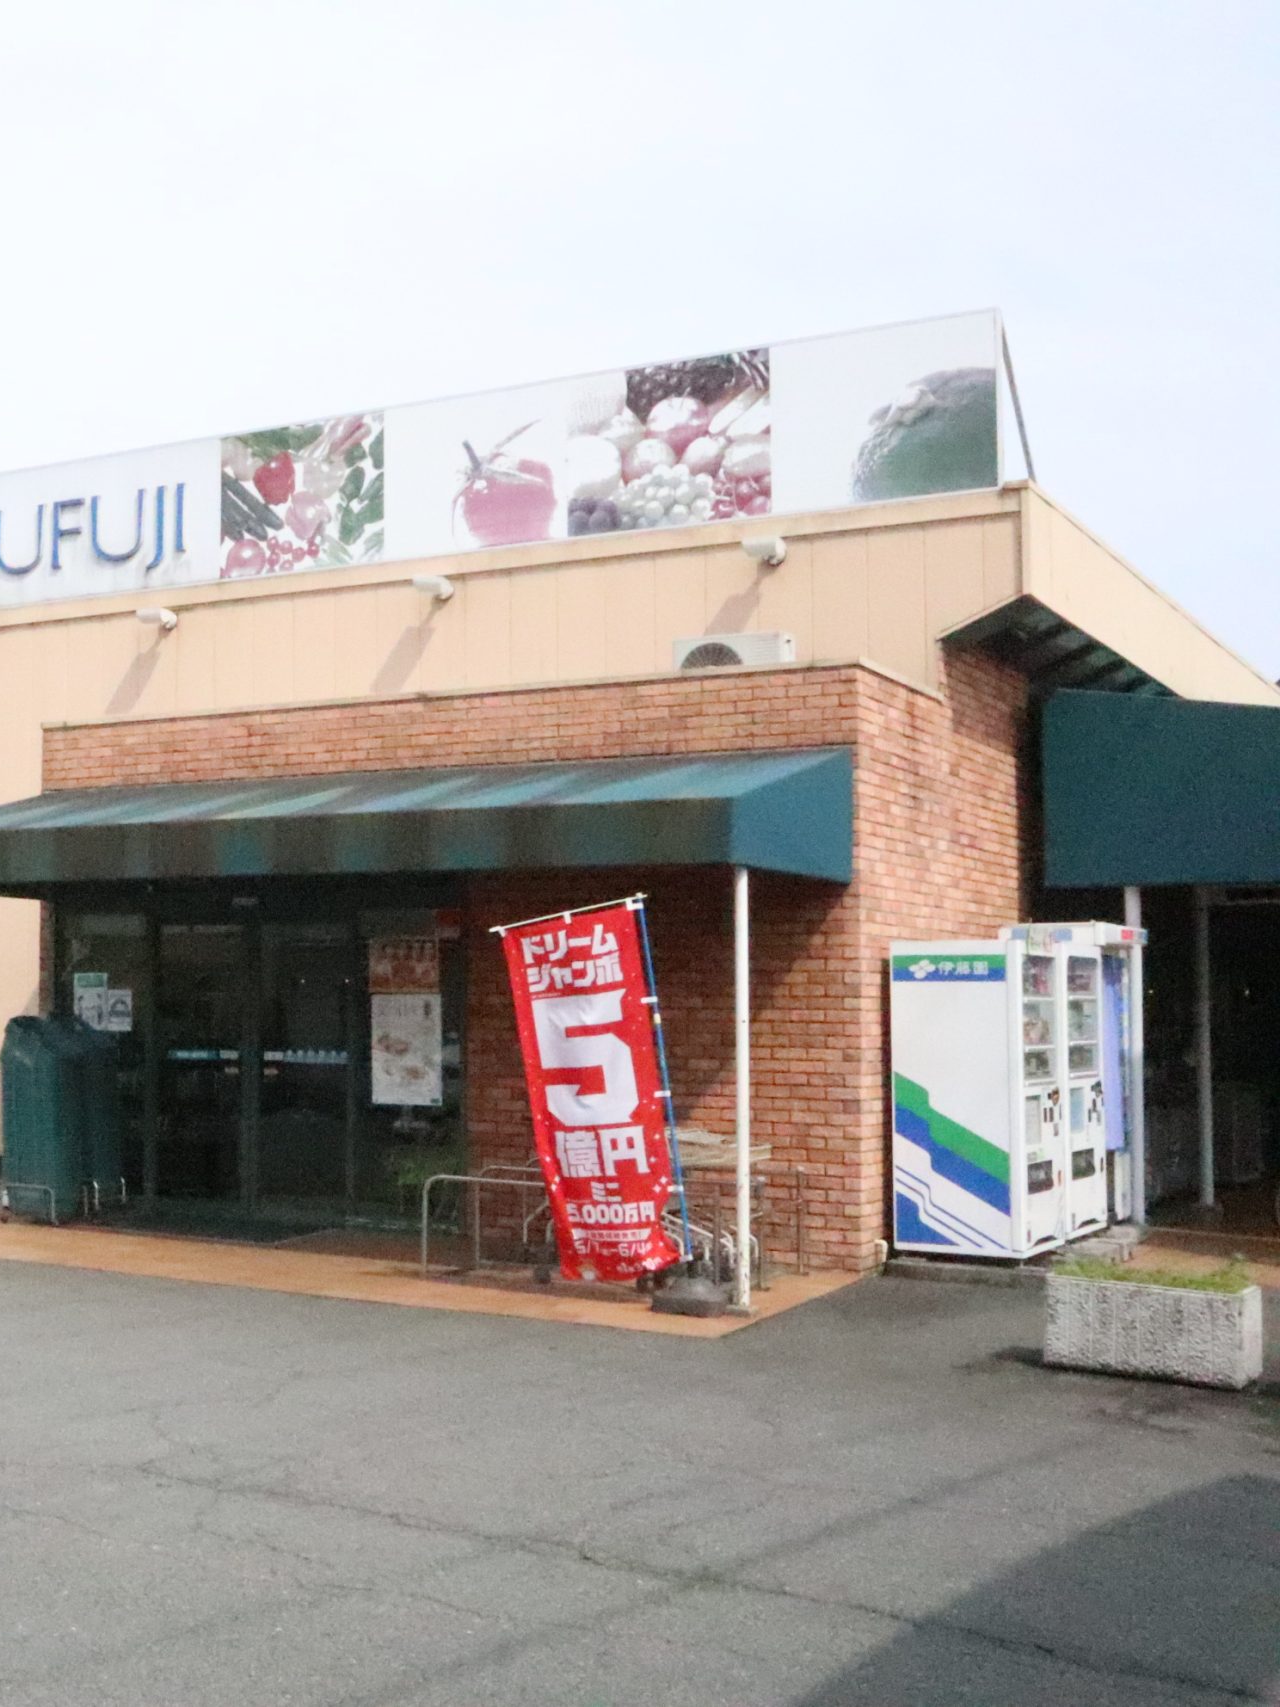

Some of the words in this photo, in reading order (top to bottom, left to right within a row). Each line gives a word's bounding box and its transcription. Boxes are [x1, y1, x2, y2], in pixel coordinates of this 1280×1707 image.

[521, 924, 618, 964] ドリーム
[526, 954, 624, 993] ジャンボ
[531, 988, 639, 1126] 5
[554, 1125, 651, 1178] 億円
[591, 1182, 622, 1202] ミニ
